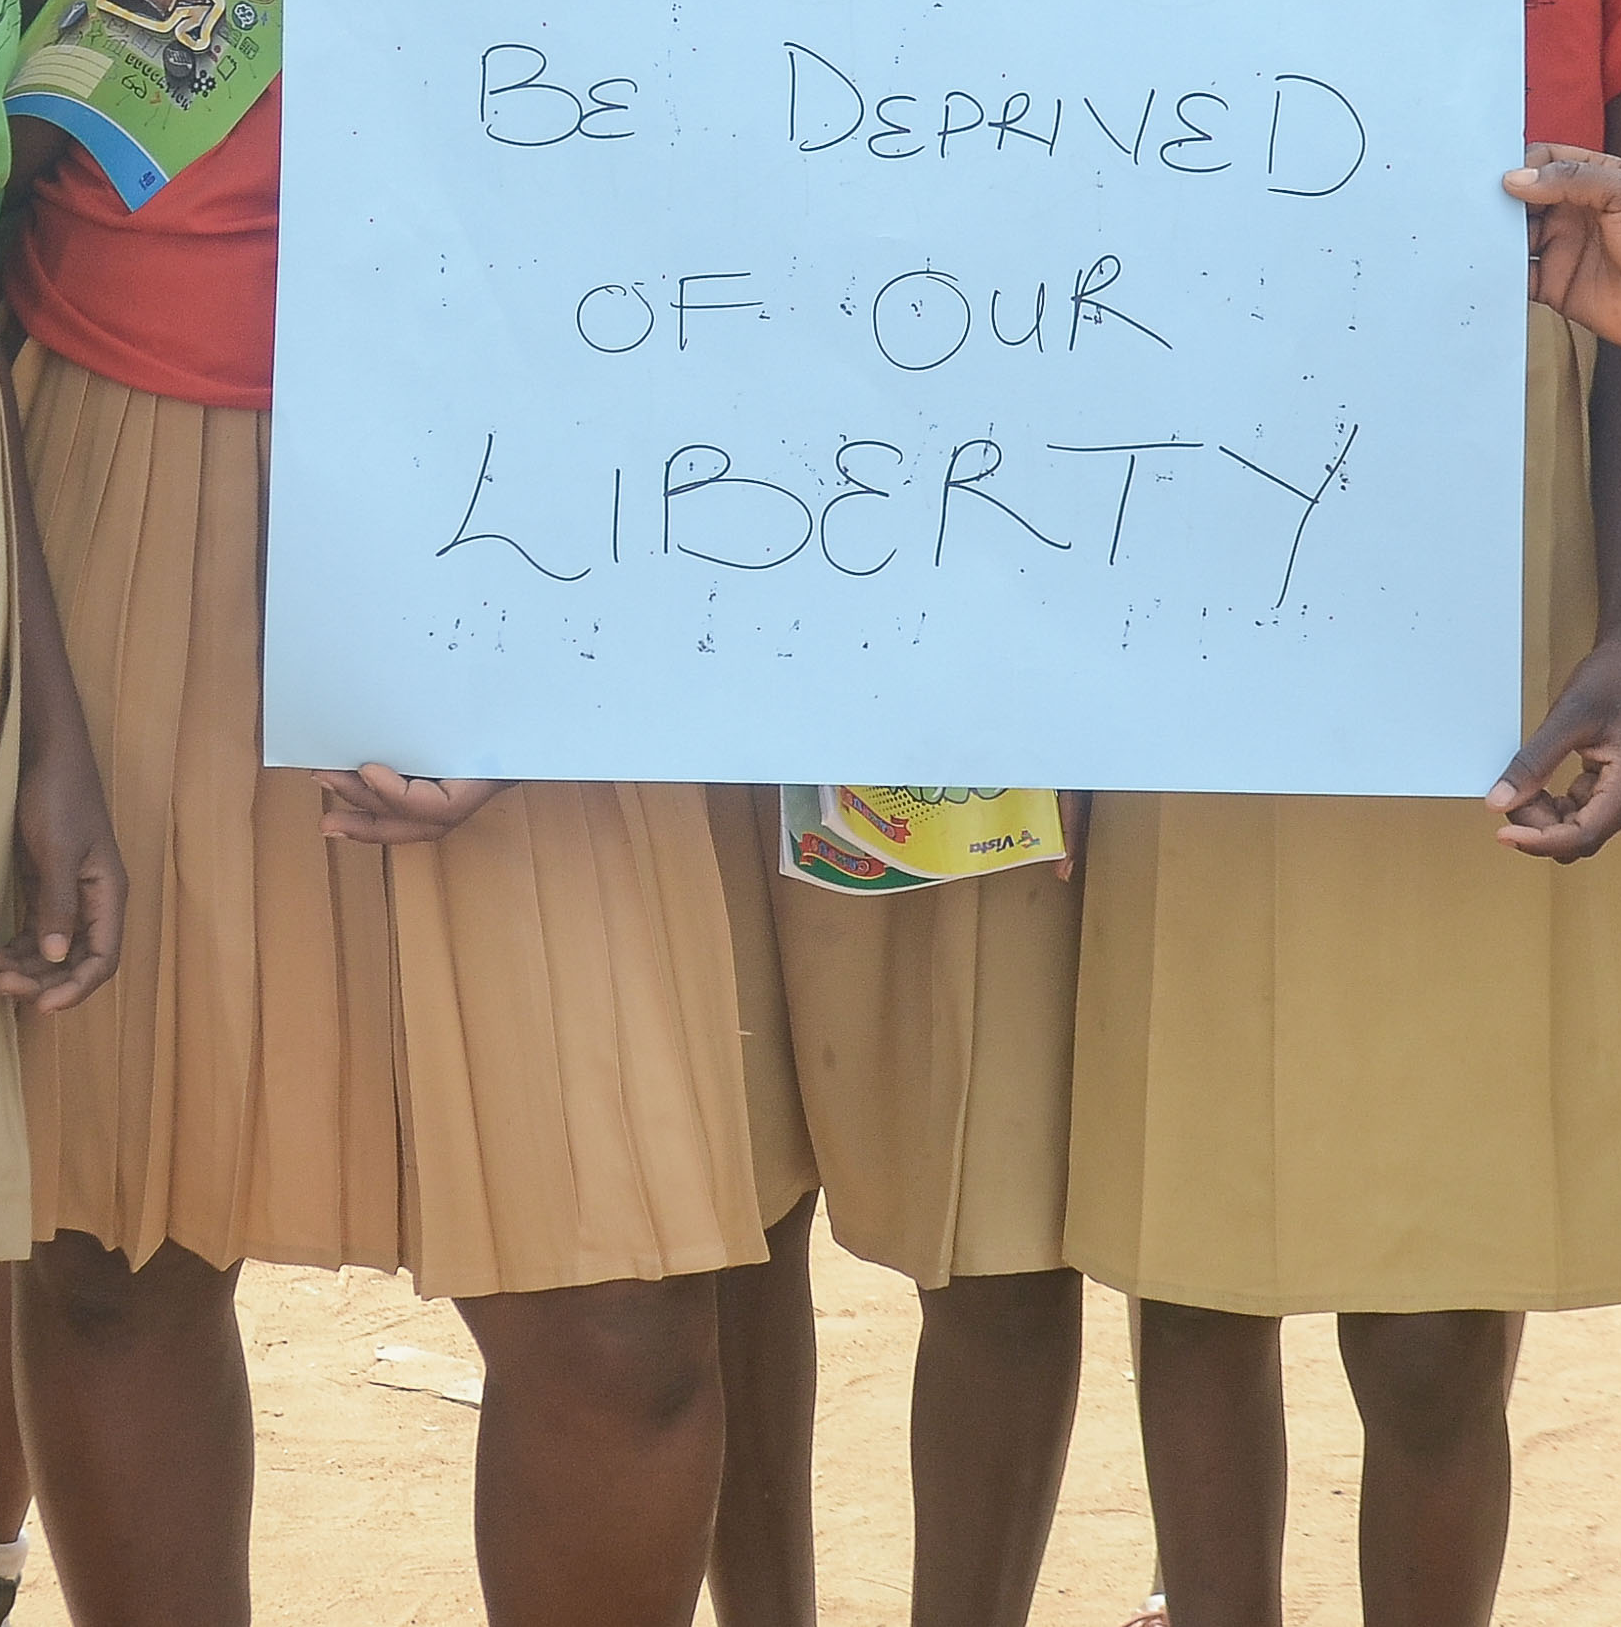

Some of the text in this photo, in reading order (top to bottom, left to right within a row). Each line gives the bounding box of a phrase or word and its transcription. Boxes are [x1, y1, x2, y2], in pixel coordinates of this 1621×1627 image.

[478, 43, 1367, 196] BE DEPRIVED
[576, 255, 1173, 371] OF OUR
[436, 422, 1360, 609] LIBERTY
